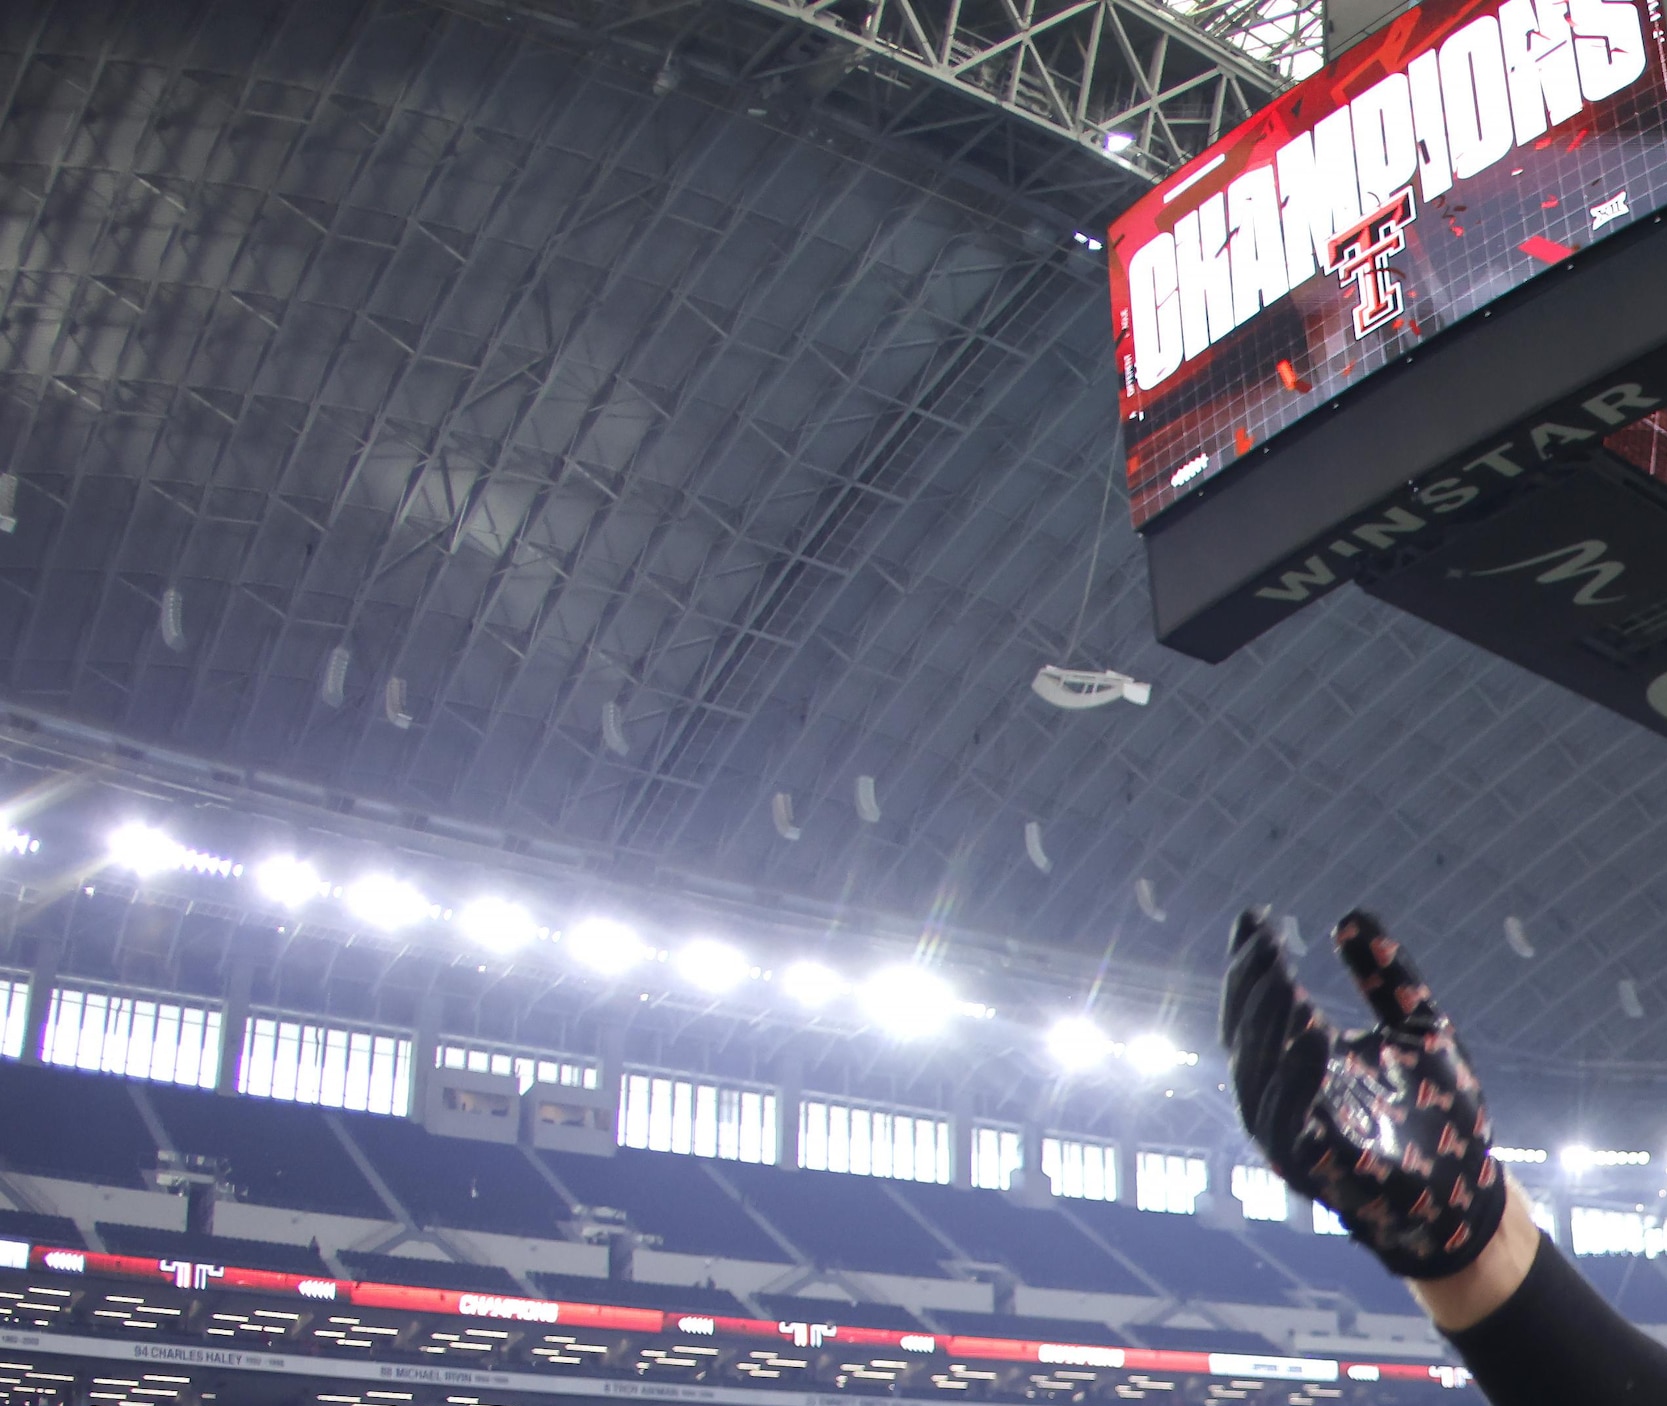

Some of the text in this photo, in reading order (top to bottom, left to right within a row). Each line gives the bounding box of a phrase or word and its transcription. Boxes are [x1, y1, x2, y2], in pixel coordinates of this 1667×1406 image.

[1129, 0, 1647, 391] CHAMPIONS
[1254, 382, 1663, 606] WINSTAR
[133, 1344, 149, 1358] 94
[150, 1346, 203, 1363] CHARLES
[204, 1351, 243, 1367] HALEY
